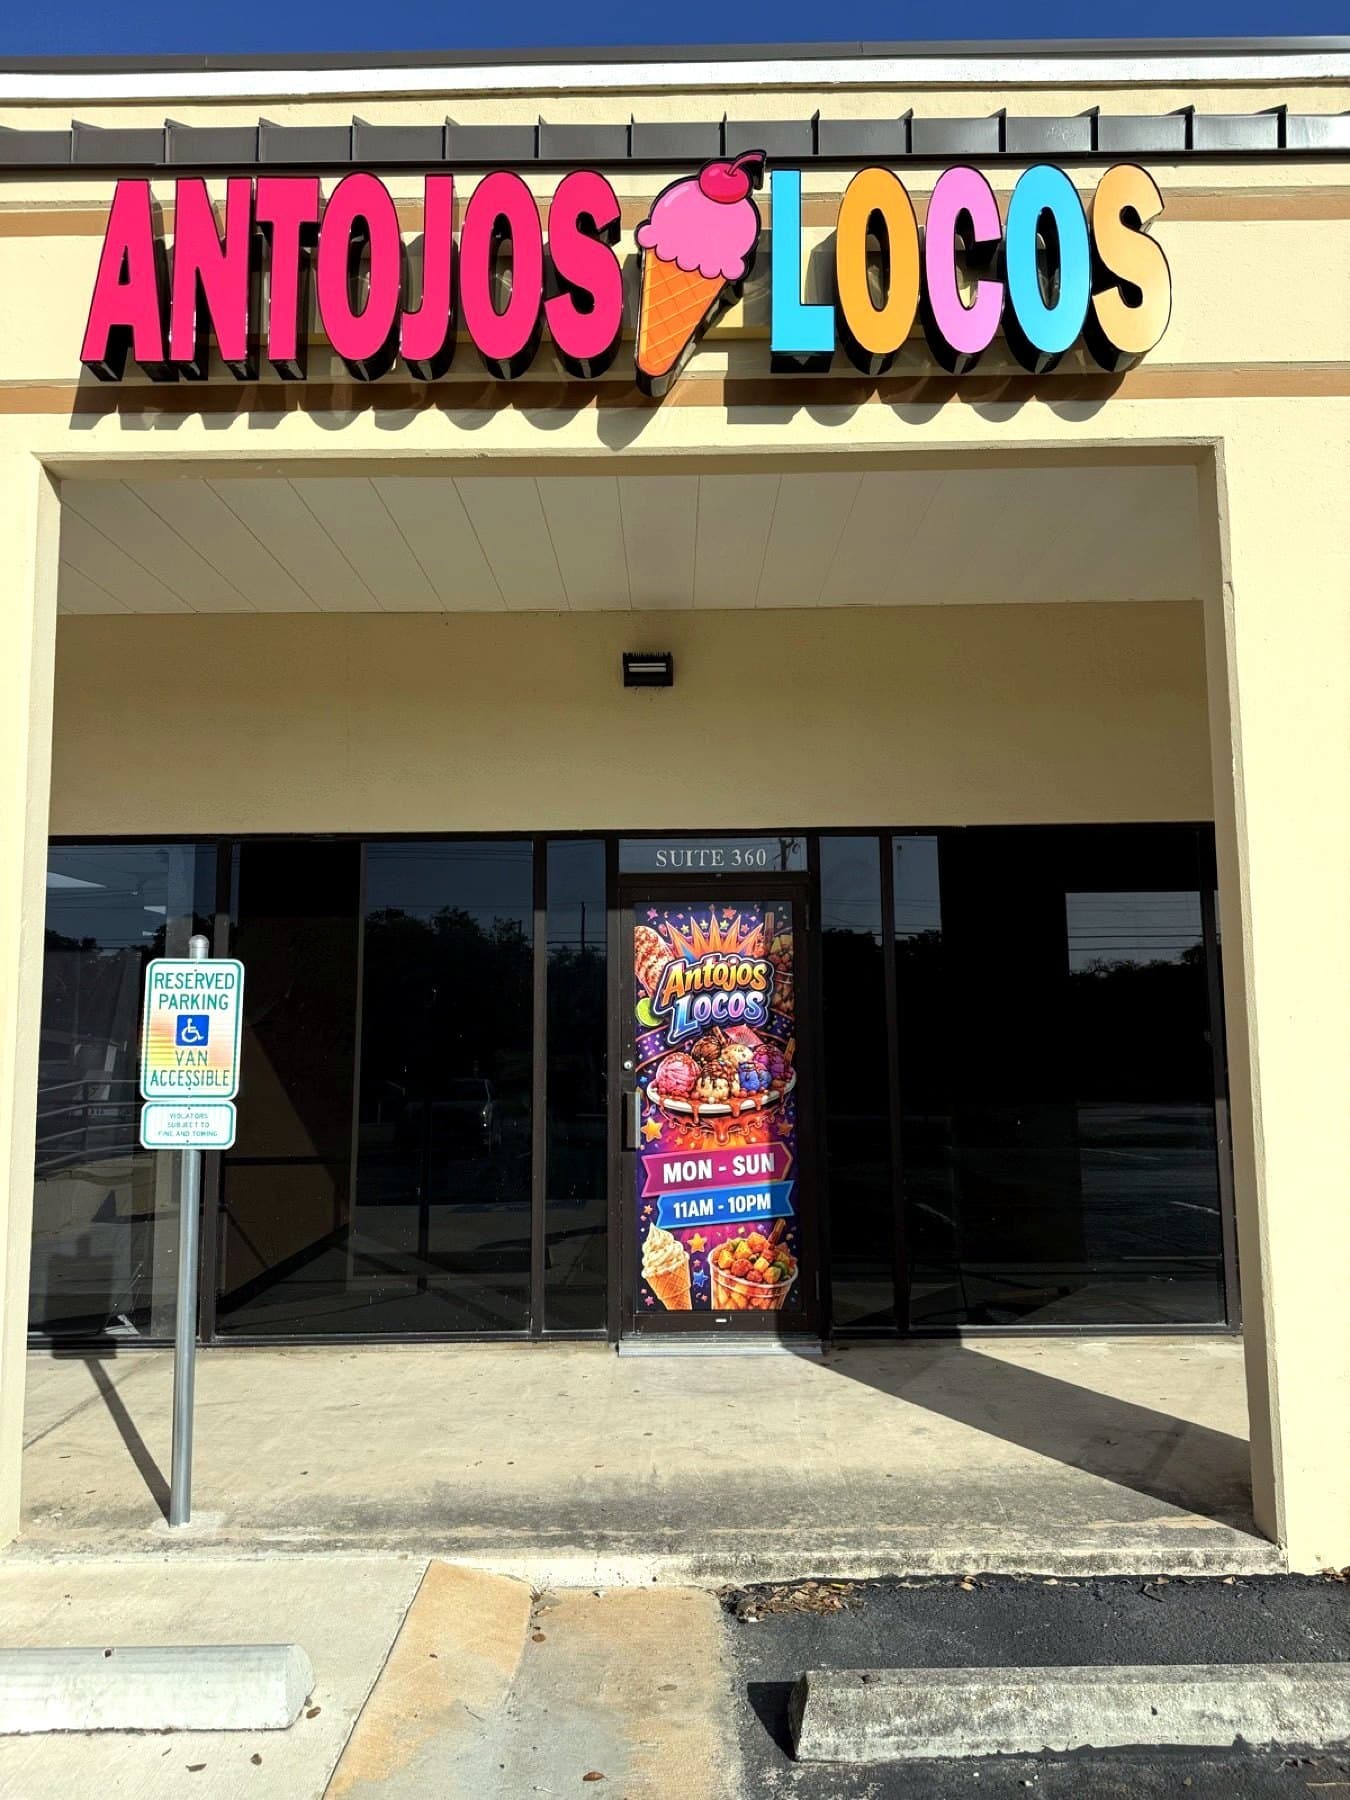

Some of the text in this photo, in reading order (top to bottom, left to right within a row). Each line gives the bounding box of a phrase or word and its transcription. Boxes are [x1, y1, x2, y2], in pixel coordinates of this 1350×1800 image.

[80, 163, 1172, 363] ANTOJOS LOCOS
[655, 848, 767, 867] SUITE 360
[154, 972, 235, 990] RESERVED
[661, 957, 768, 1007] Antojos
[158, 993, 229, 1010] PARKING
[175, 1050, 208, 1067] VAN
[150, 1069, 231, 1087] ACCESSIBLE
[169, 1112, 209, 1120] VIOLATORS
[663, 1159, 713, 1184] MON
[732, 1153, 775, 1176] SUN
[673, 1198, 714, 1218] 11AM
[727, 1193, 771, 1213] 10PM
